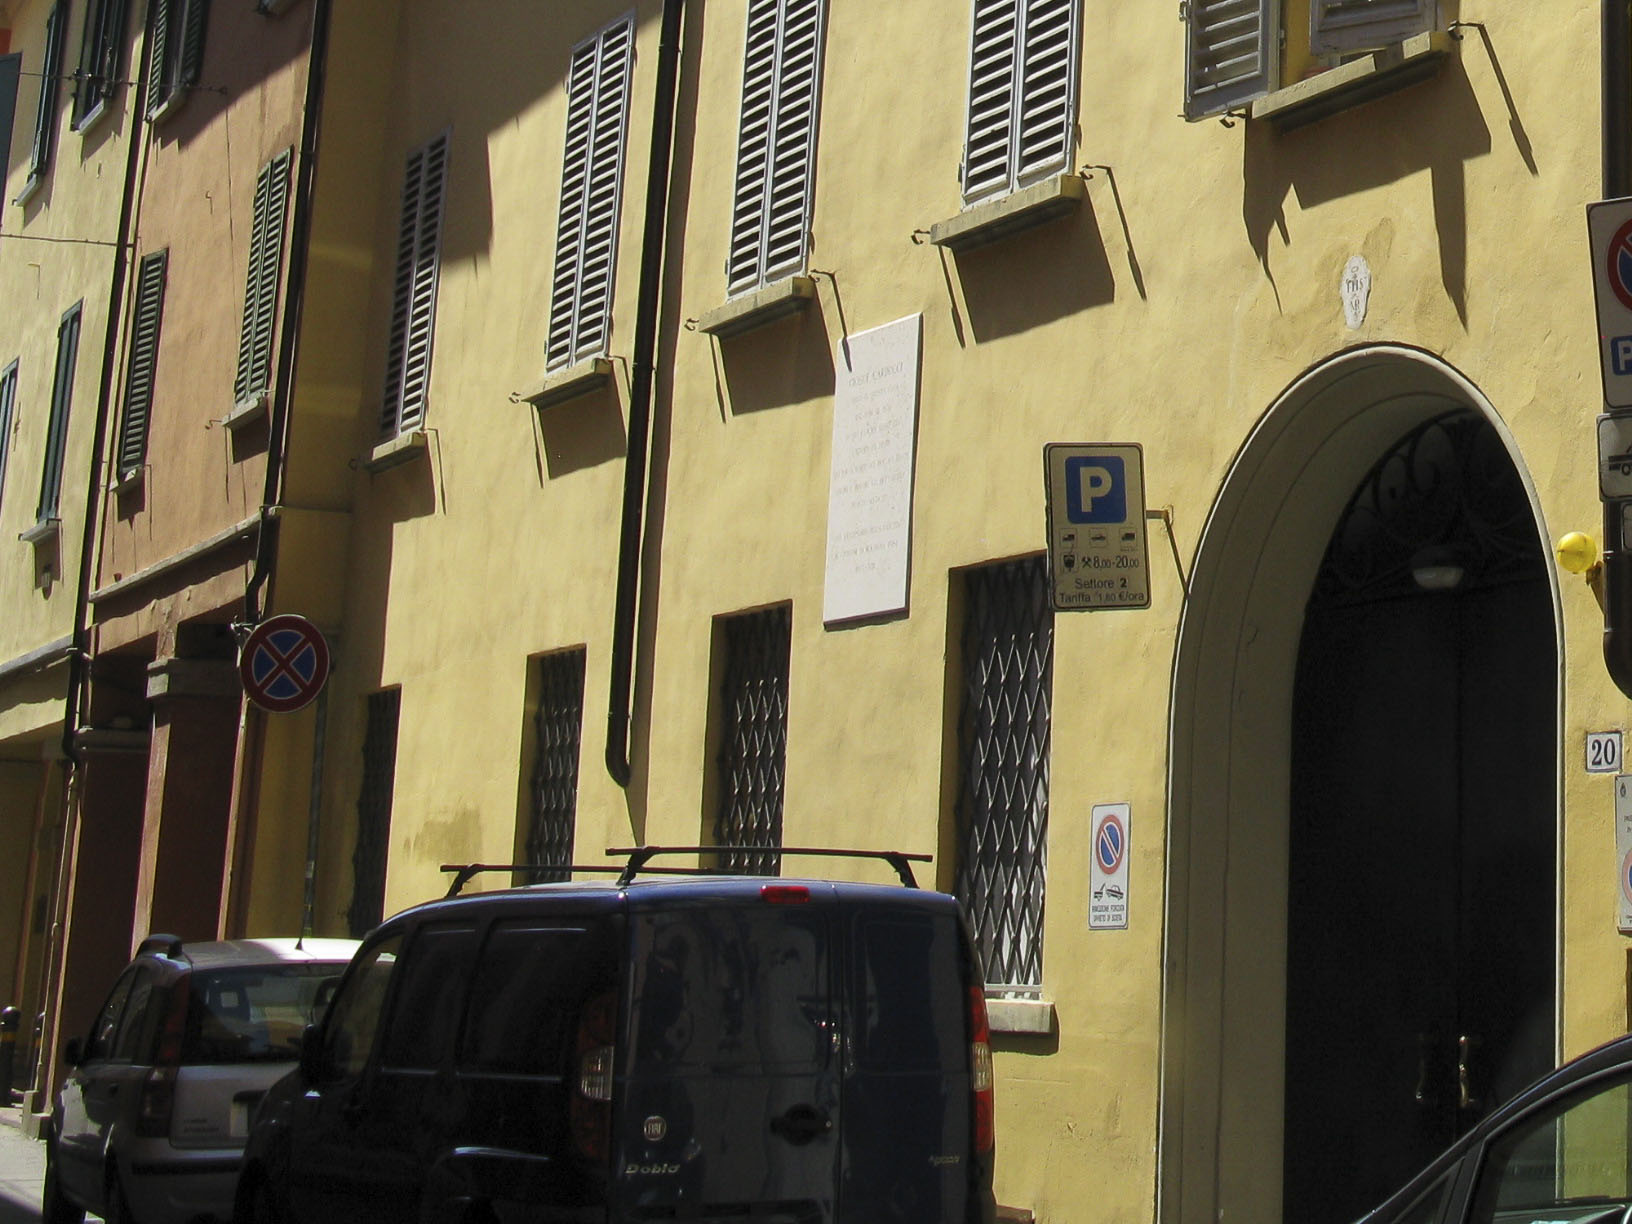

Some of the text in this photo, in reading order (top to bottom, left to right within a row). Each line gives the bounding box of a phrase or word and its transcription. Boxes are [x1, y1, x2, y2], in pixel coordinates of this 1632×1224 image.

[1079, 466, 1113, 513] P
[1074, 577, 1128, 590] Settore 2
[1059, 593, 1091, 604] Tariffa
[1591, 738, 1616, 766] 20
